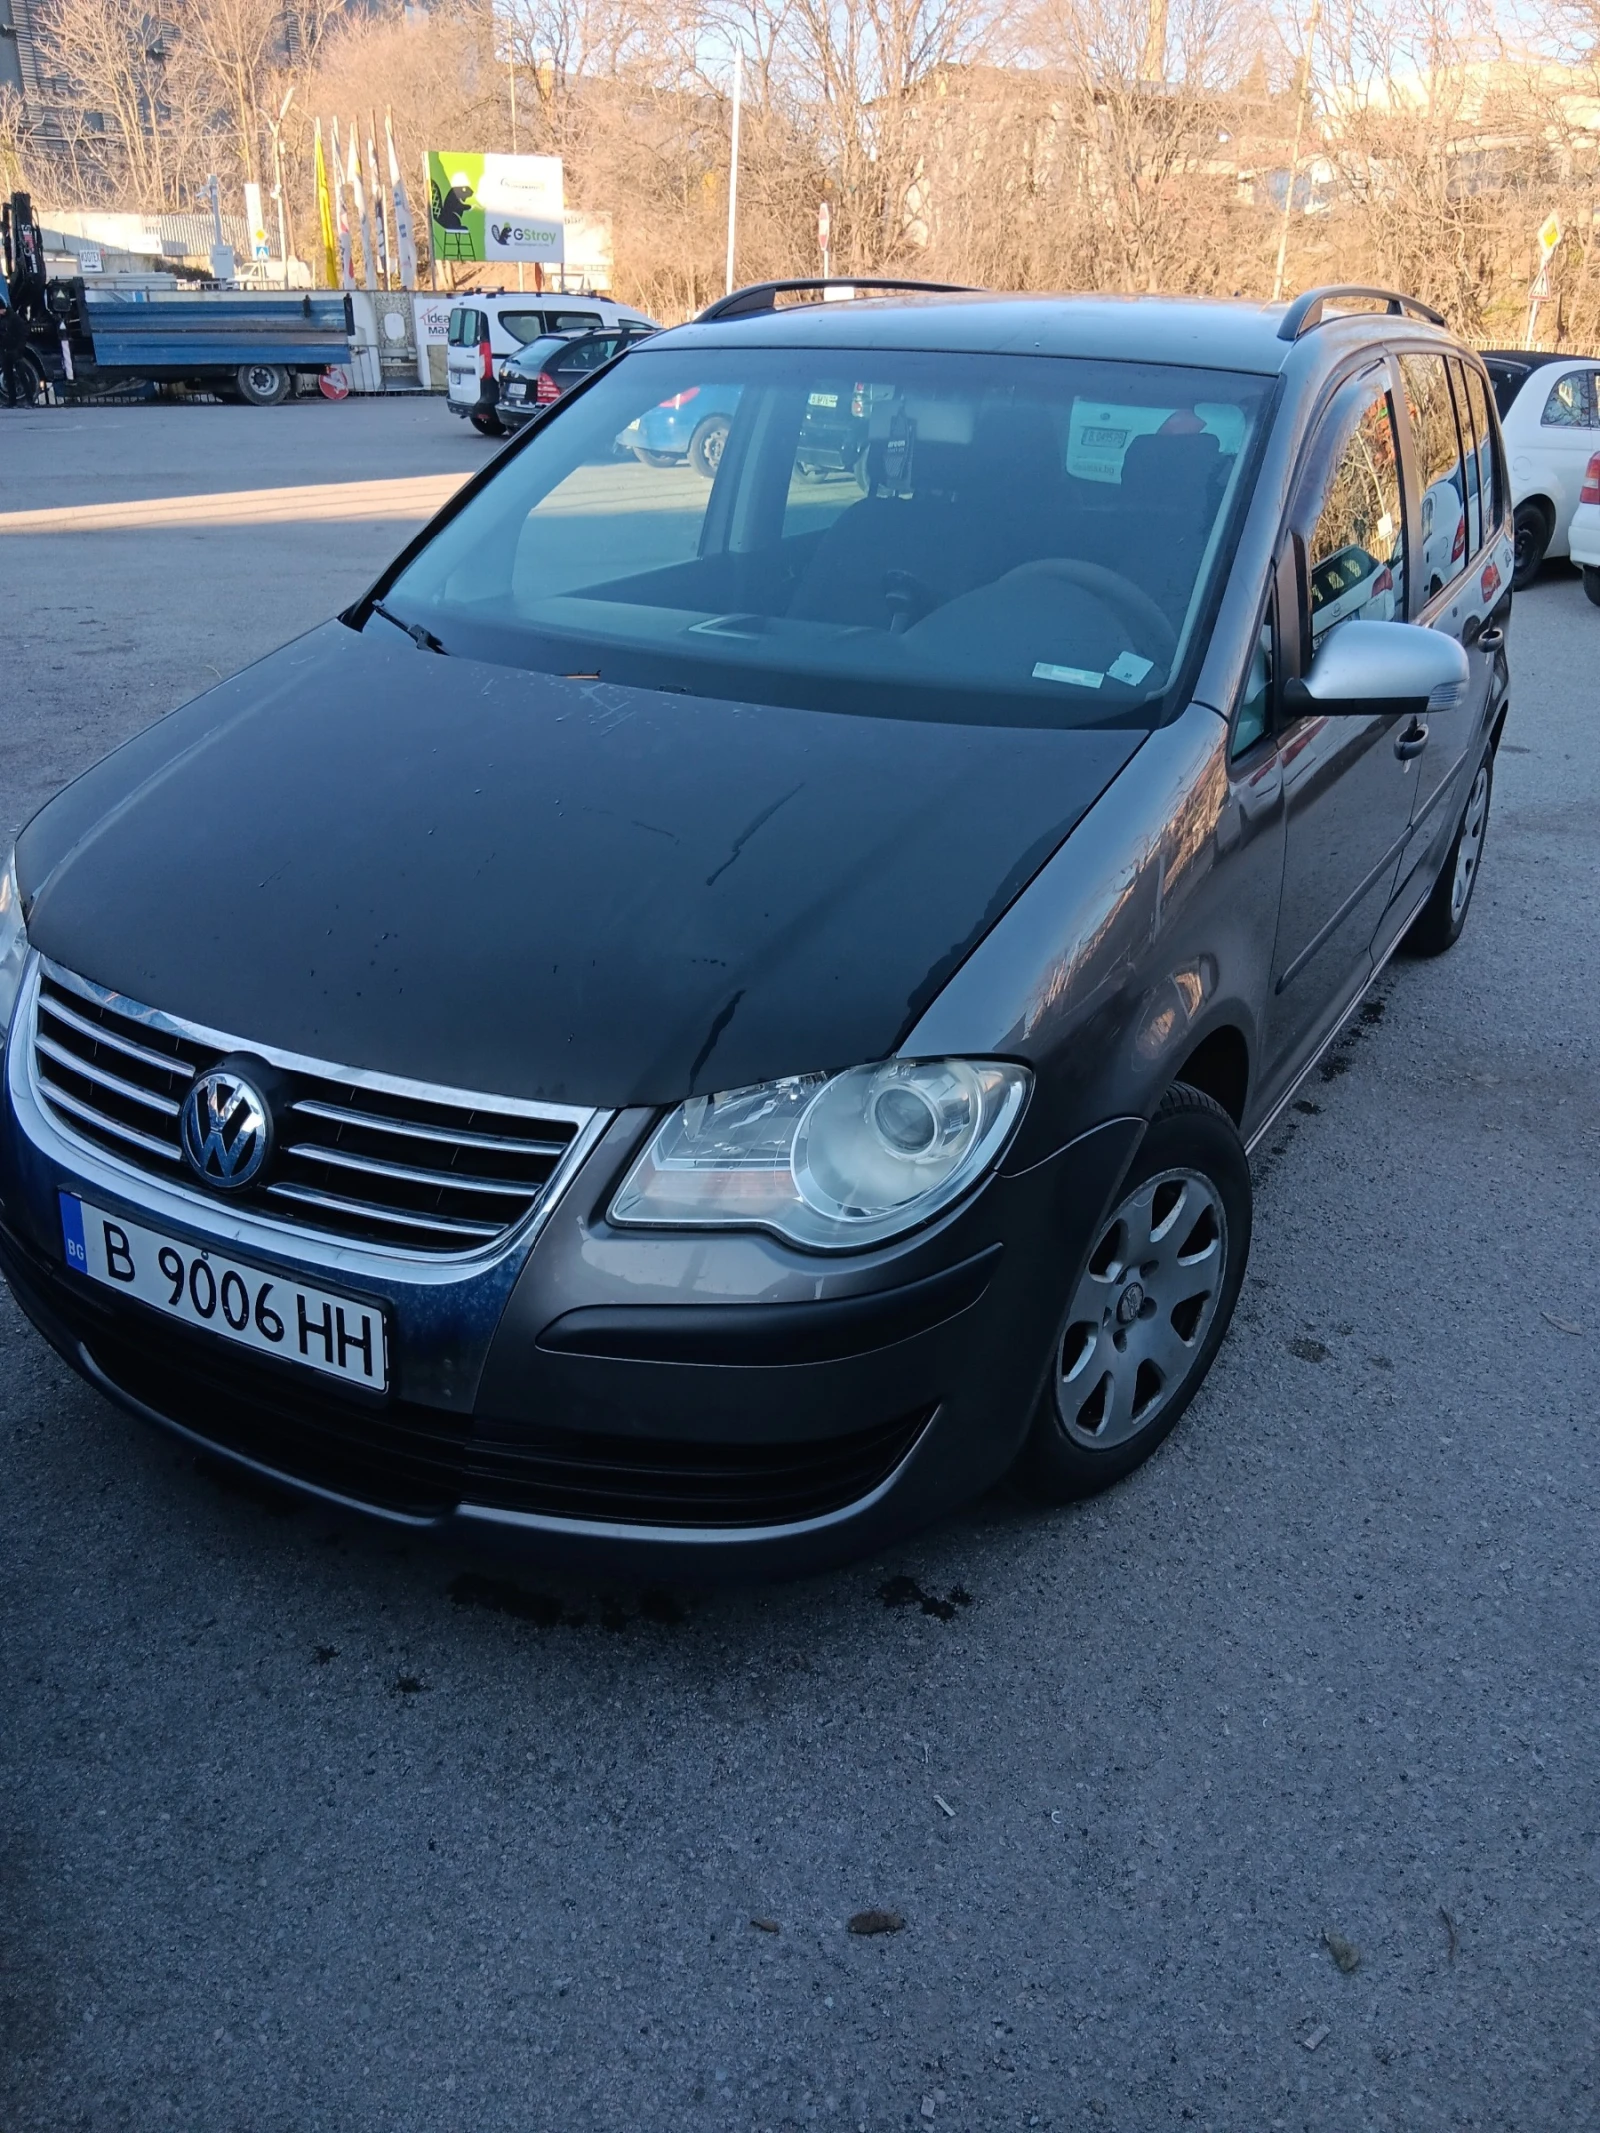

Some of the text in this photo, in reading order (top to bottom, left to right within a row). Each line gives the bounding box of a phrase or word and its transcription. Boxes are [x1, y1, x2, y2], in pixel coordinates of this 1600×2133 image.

[513, 228, 556, 245] GStroy
[67, 1238, 85, 1261] BG
[102, 1220, 373, 1377] B 9006 HH
